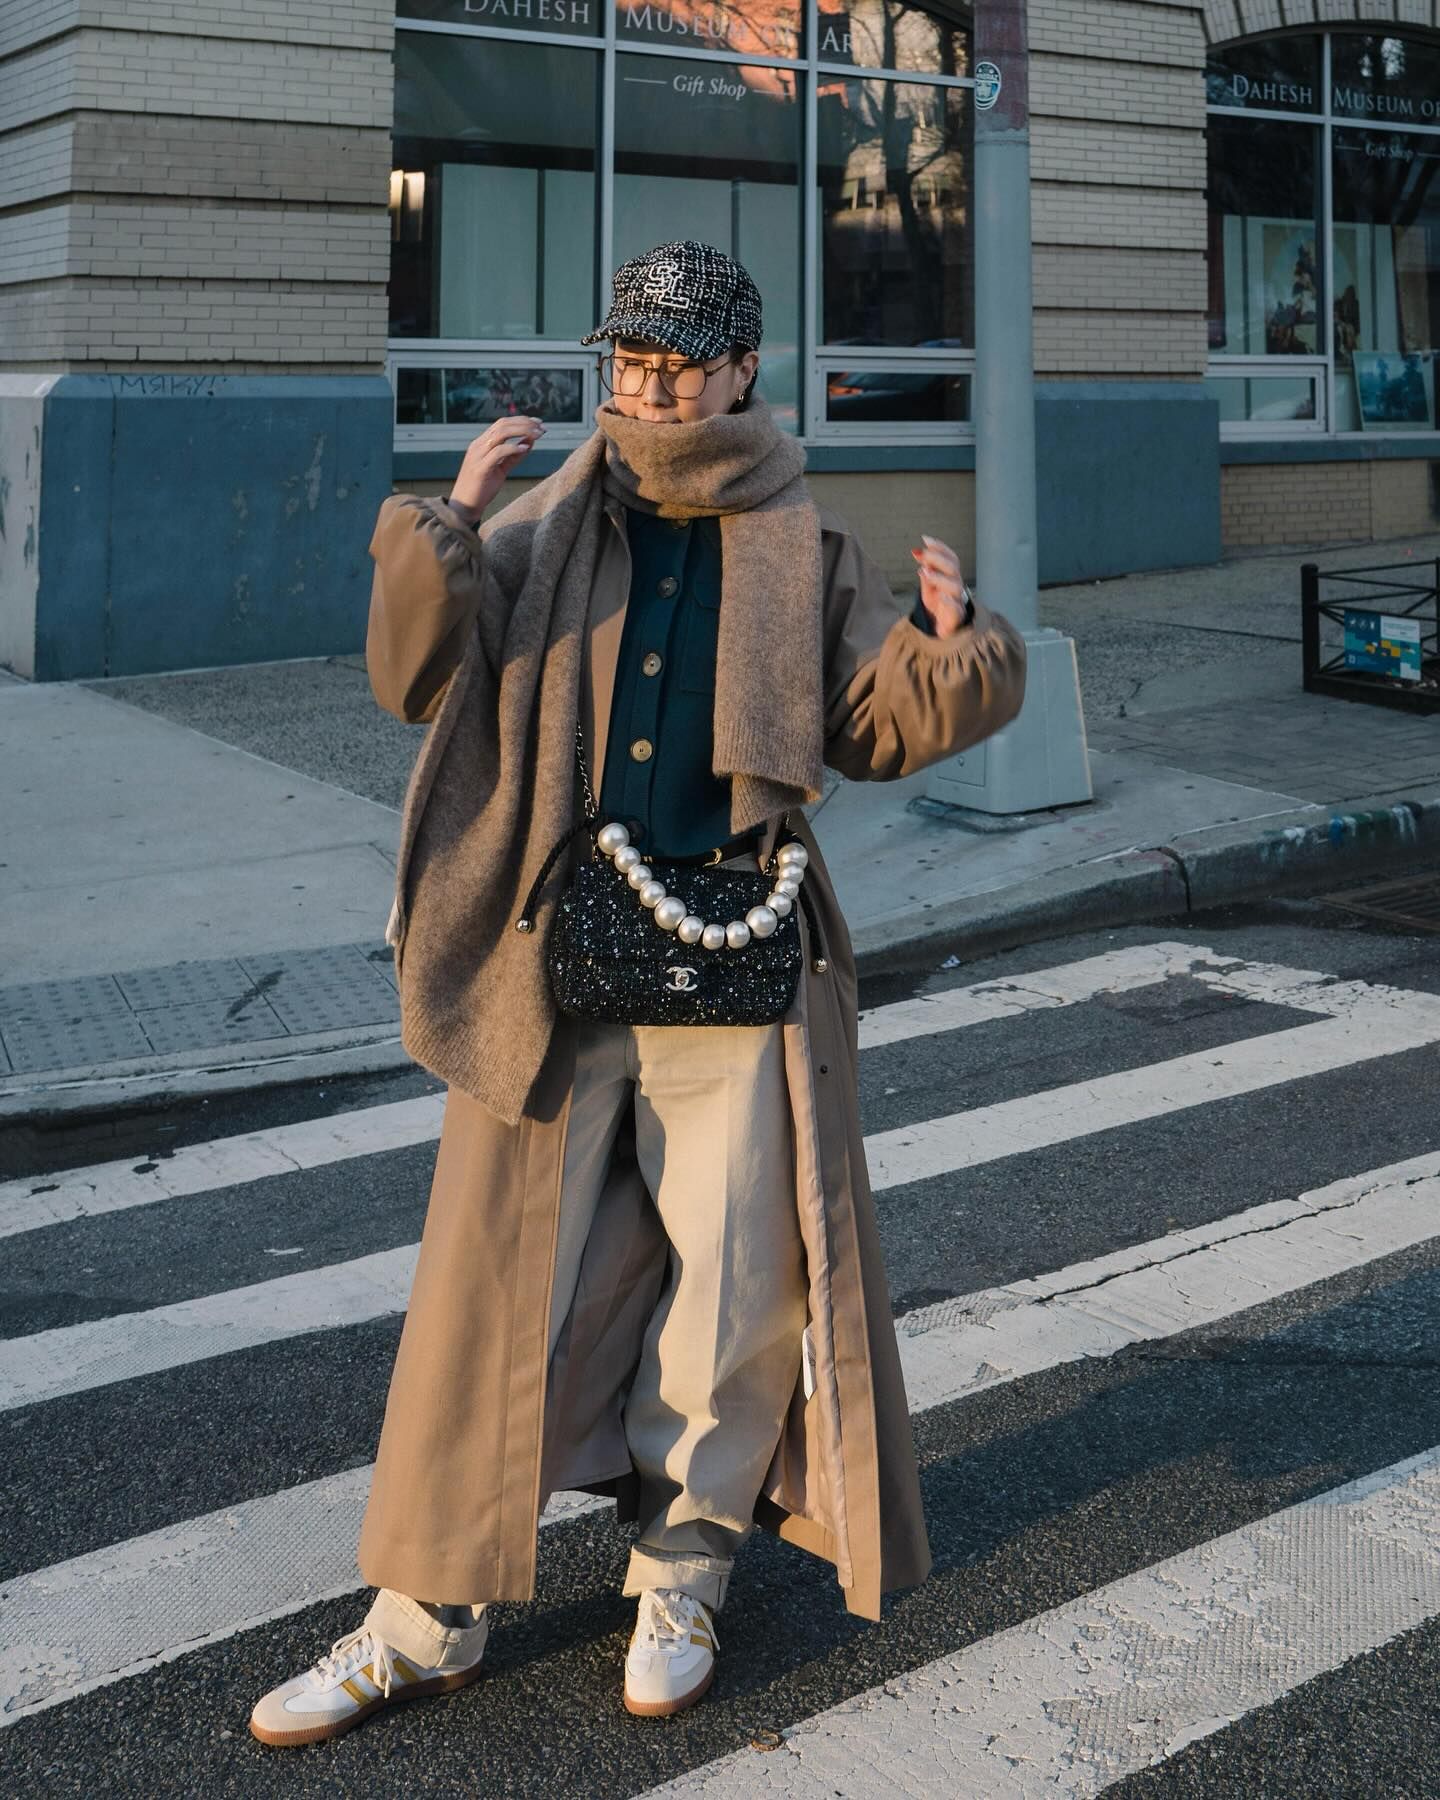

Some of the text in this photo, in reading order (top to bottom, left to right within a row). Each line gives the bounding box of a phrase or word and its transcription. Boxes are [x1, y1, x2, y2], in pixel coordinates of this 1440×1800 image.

[673, 74, 746, 100] Gift Shop
[1233, 74, 1313, 104] DAHESH
[1334, 87, 1413, 114] MUSEUM
